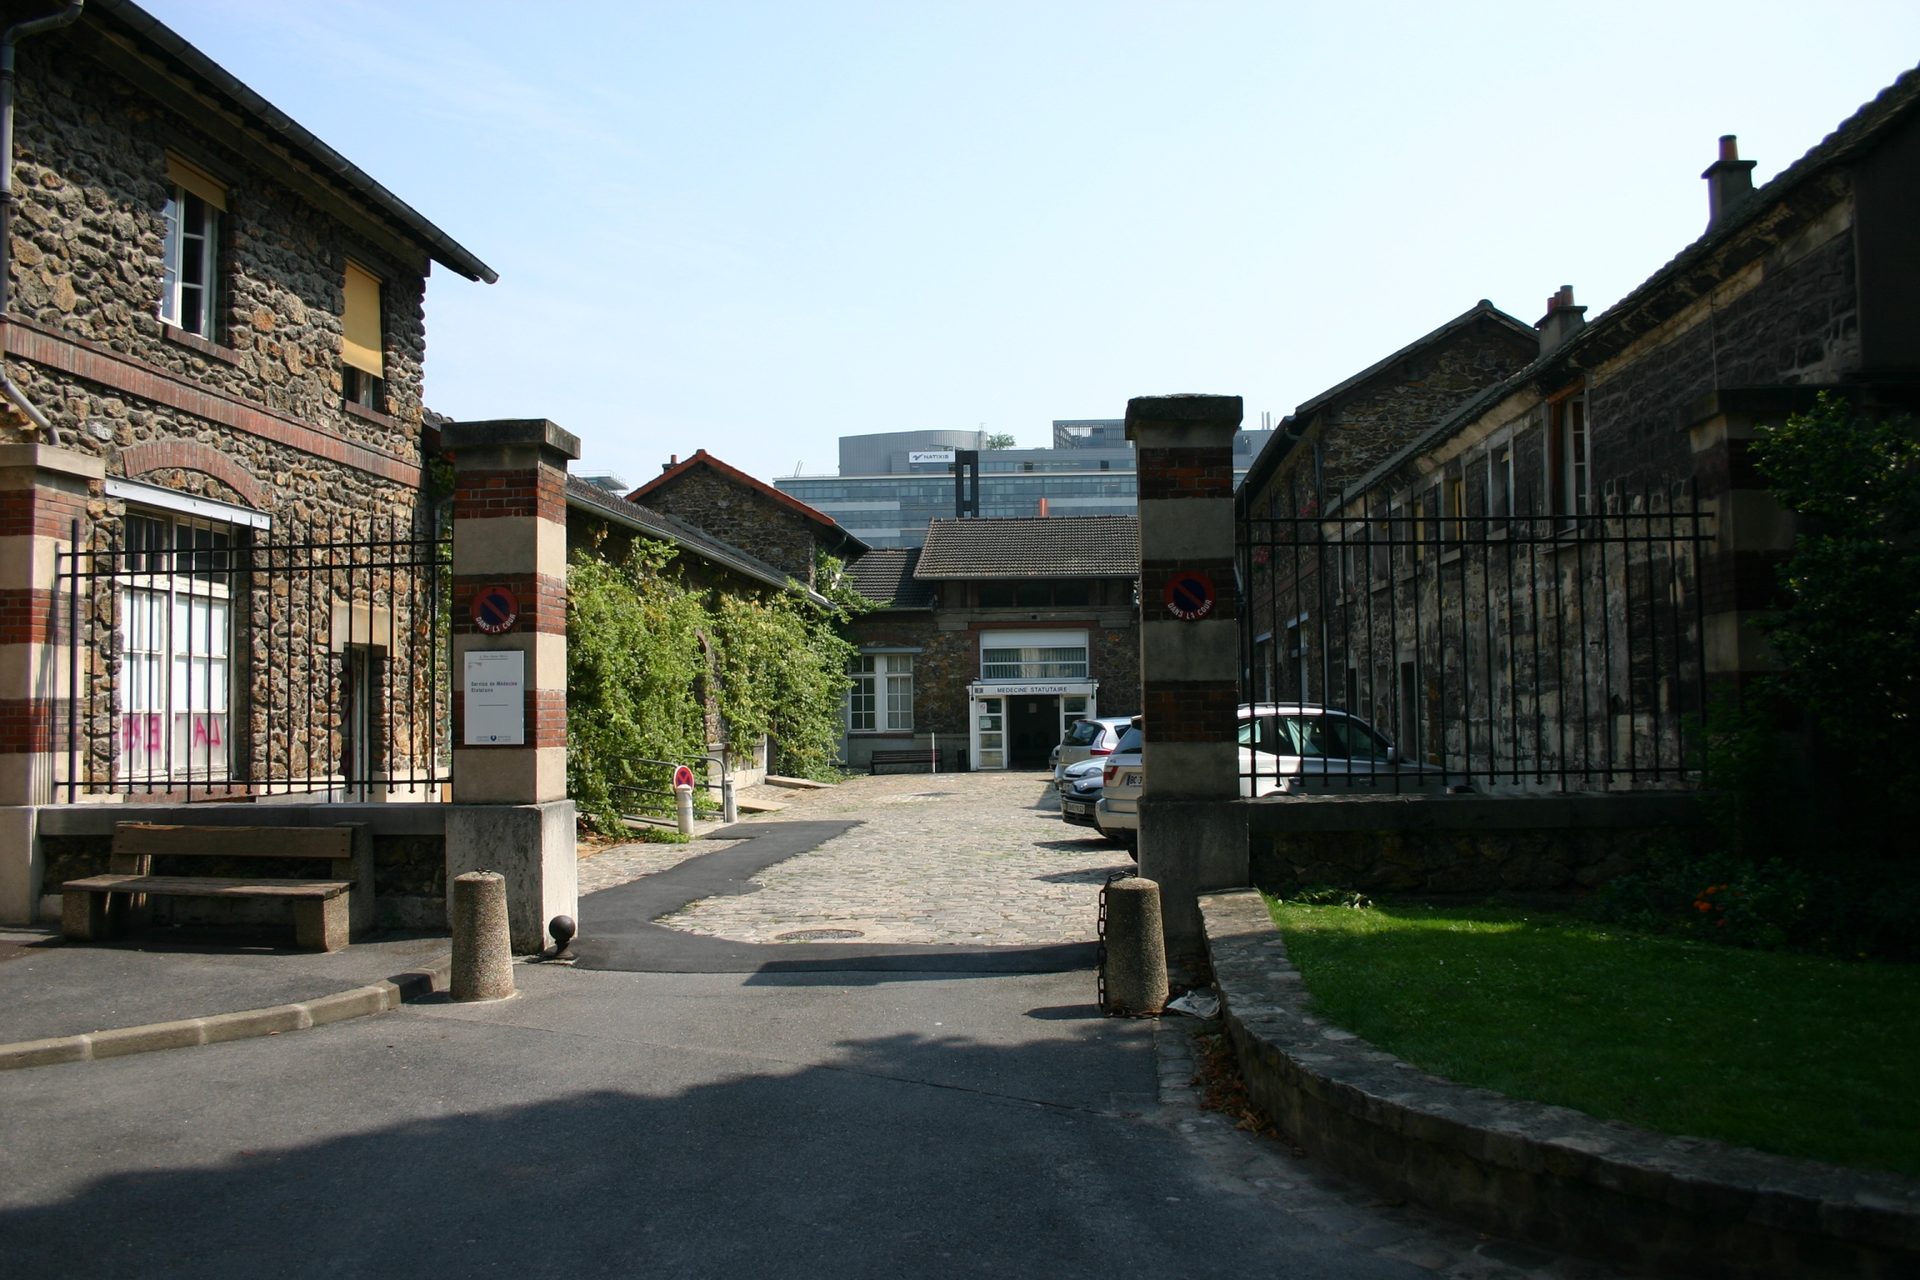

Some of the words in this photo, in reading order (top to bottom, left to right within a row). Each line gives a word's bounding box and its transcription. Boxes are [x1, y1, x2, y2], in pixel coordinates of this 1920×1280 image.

[1167, 602, 1184, 618] DANS
[1197, 599, 1212, 616] COUR
[475, 616, 490, 631] DANS
[492, 625, 501, 633] LA
[502, 613, 516, 629] COUR
